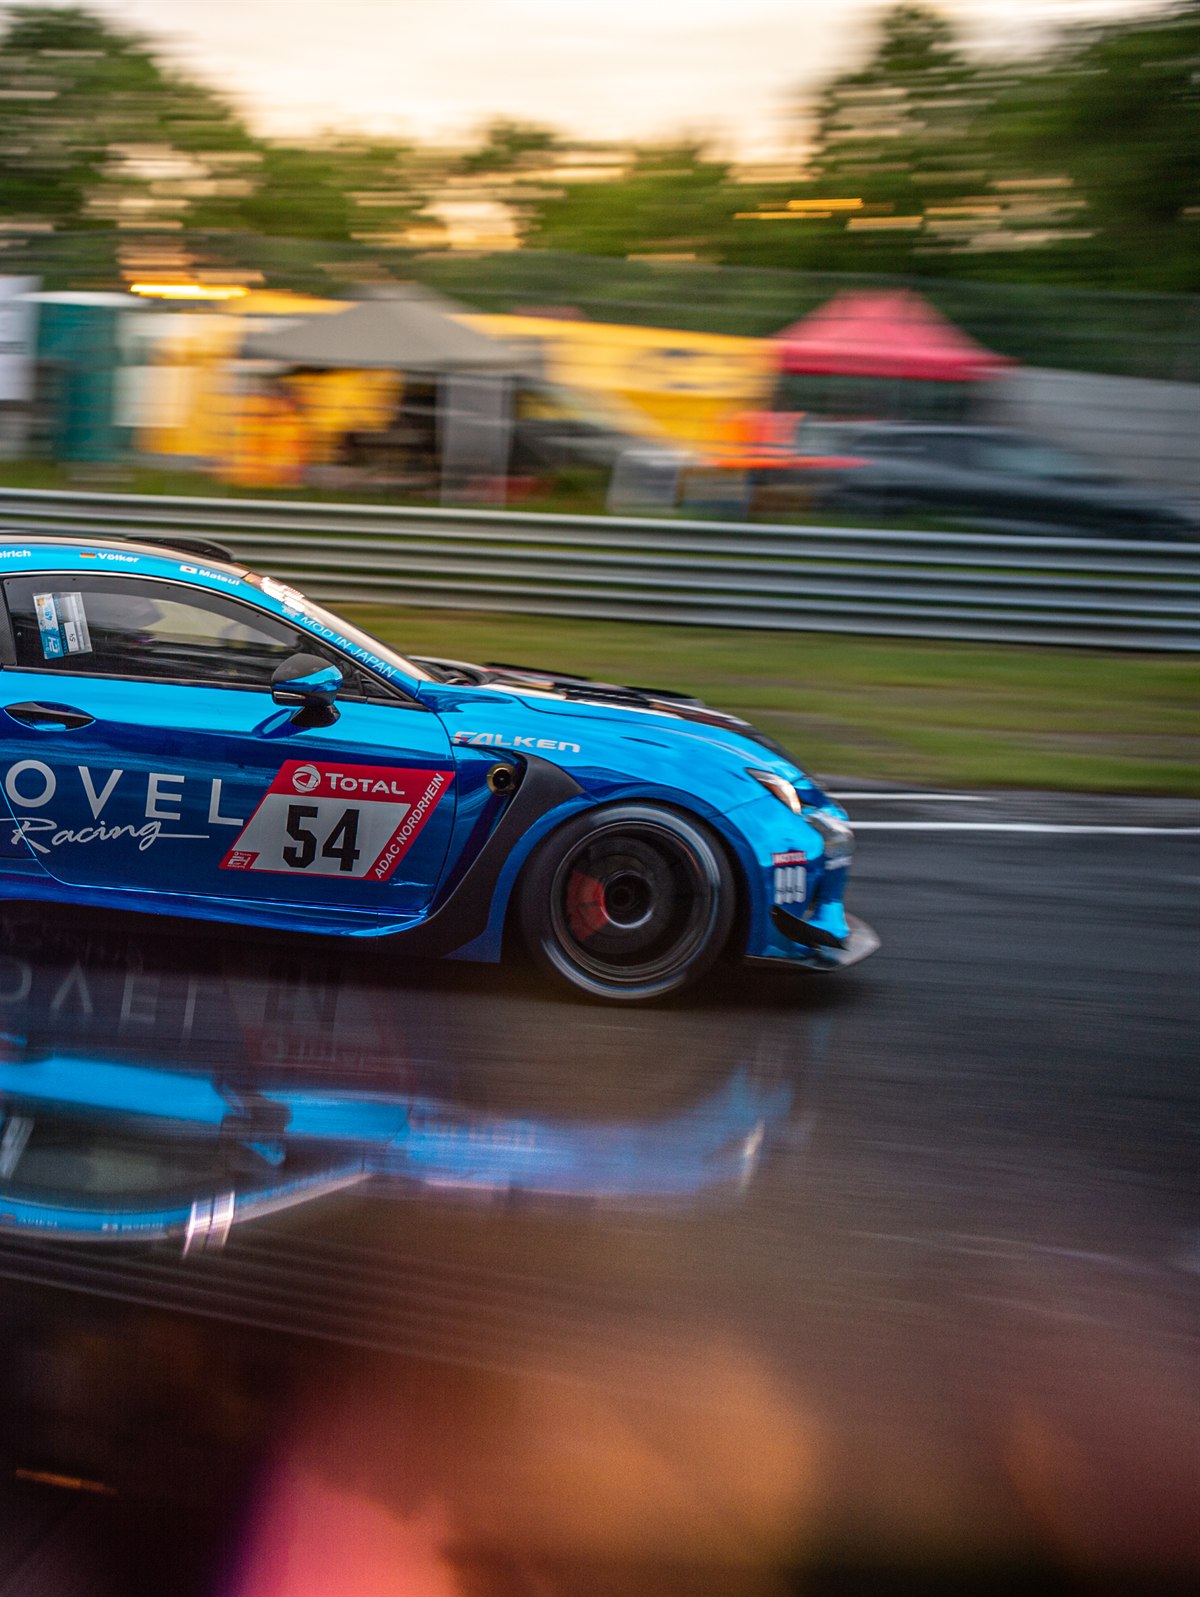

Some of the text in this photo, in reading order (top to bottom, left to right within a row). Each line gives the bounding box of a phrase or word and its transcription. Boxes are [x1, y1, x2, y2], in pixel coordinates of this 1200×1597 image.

[97, 552, 140, 564] Völker
[301, 615, 398, 679] MOD IN JAPAN
[452, 730, 581, 753] FALKEN
[325, 772, 406, 796] TOTAL
[282, 804, 361, 872] 54
[374, 772, 445, 879] ADAC NORDRHEIN
